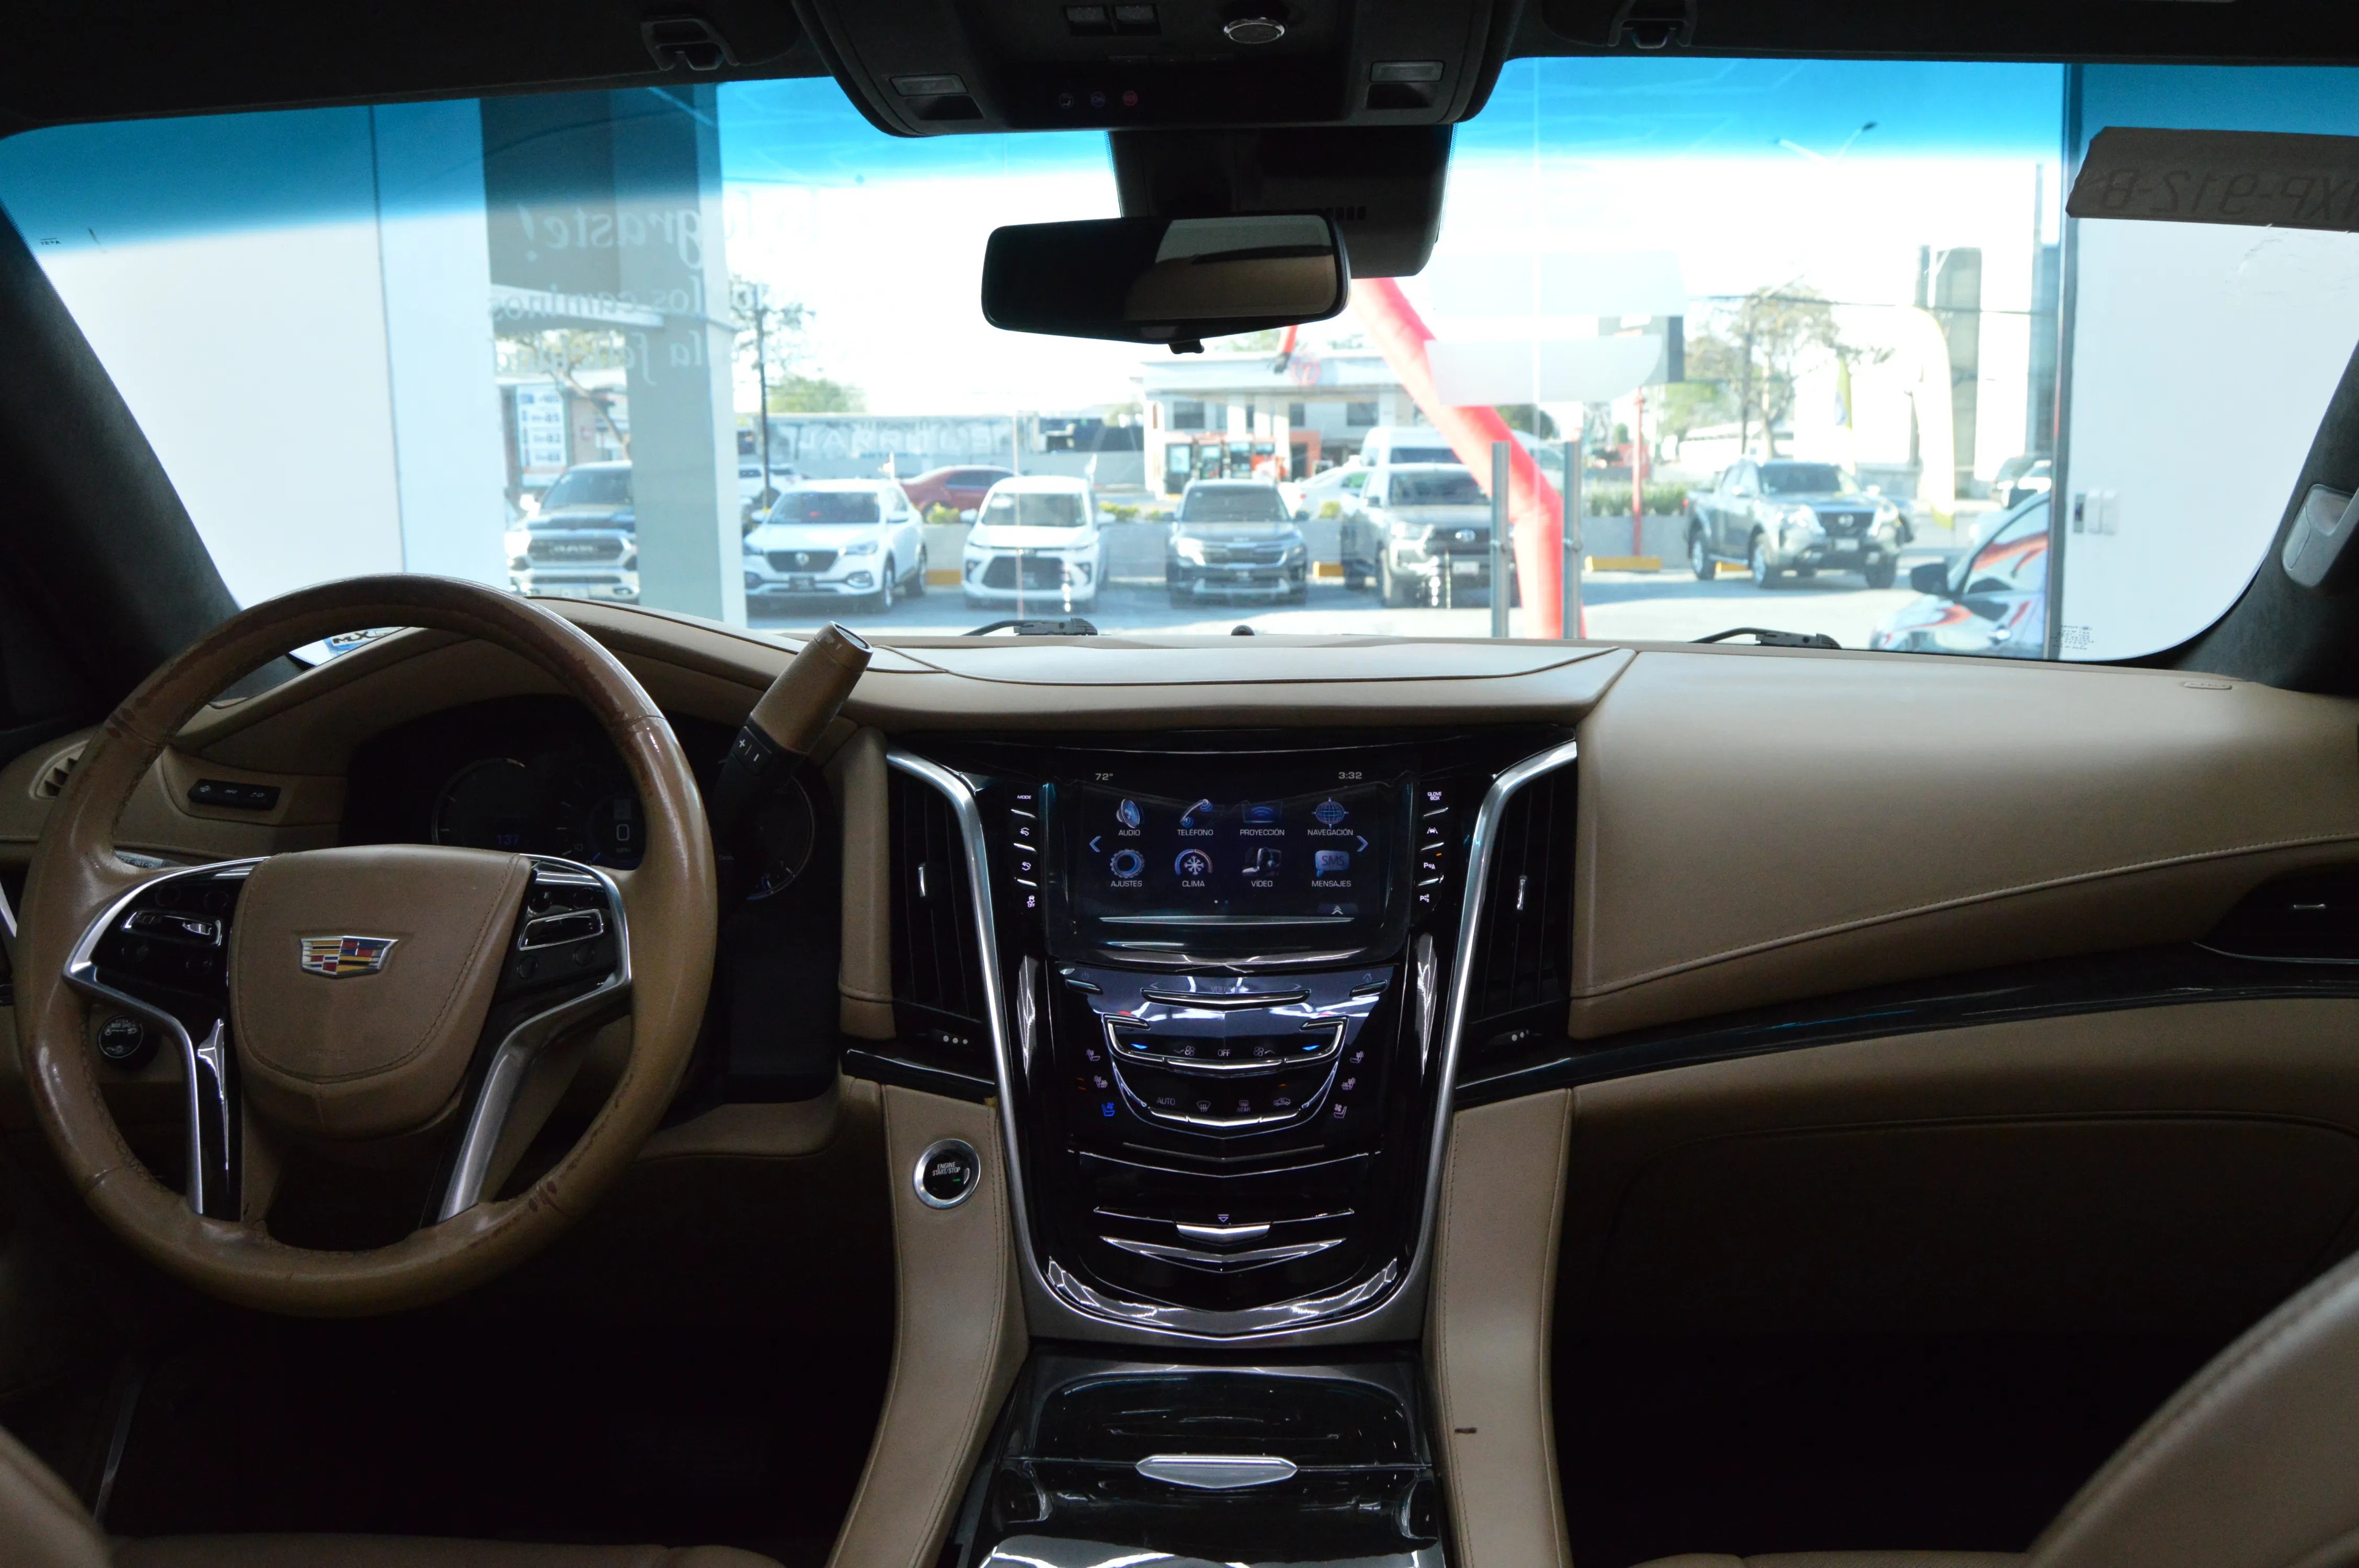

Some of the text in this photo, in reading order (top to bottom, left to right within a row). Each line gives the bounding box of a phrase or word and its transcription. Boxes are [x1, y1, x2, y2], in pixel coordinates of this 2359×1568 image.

[1177, 827, 1213, 836] TELÉFONO
[1240, 827, 1285, 836] PROYECCIÓN
[1308, 827, 1353, 836] NAVEGACIÓN
[1322, 855, 1345, 866] SMS
[932, 1167, 960, 1176] START/STOP
